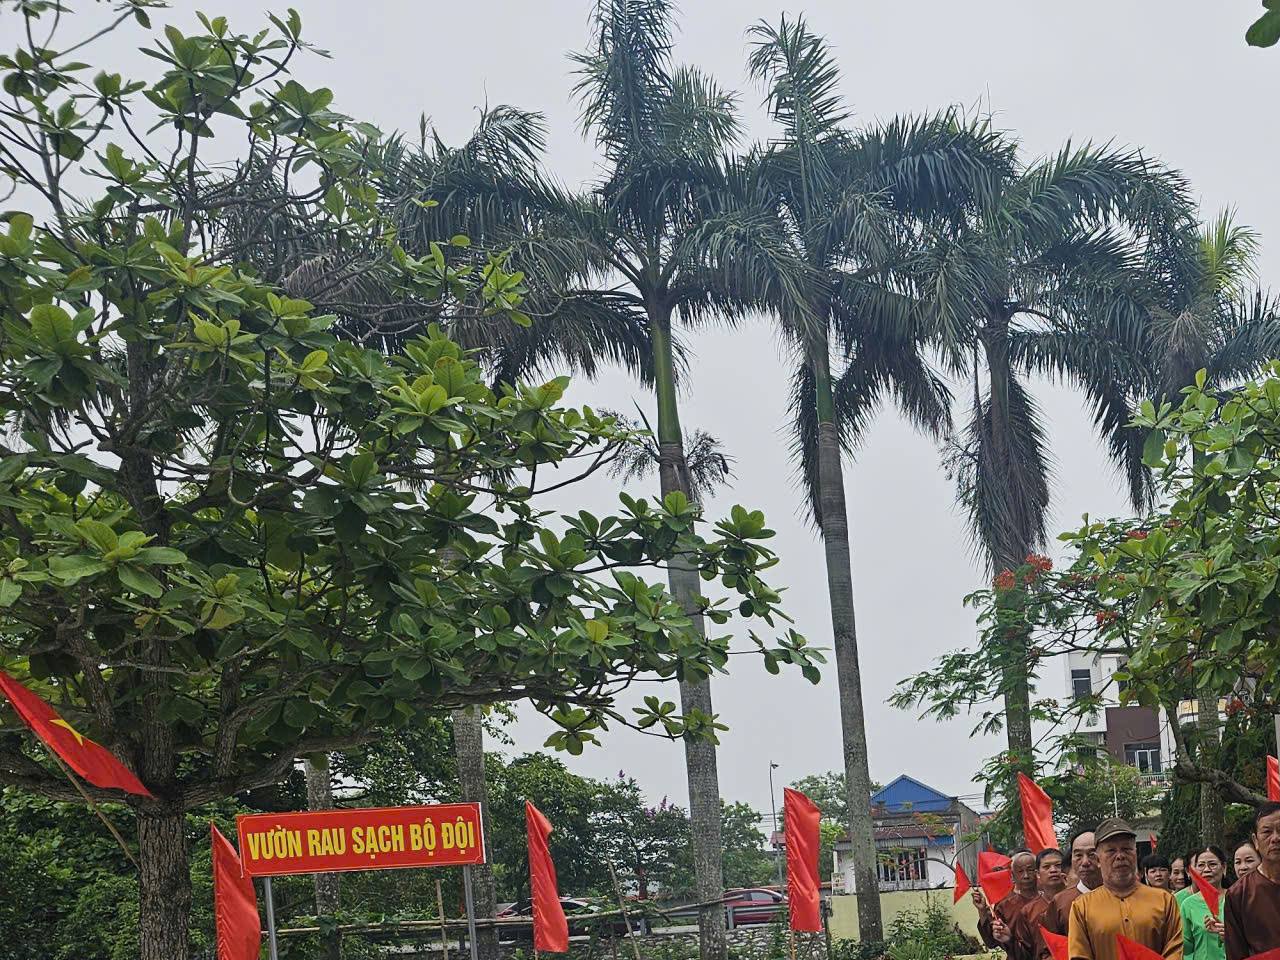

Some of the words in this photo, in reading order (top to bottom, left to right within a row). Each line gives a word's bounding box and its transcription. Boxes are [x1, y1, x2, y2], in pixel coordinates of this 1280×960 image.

[246, 824, 302, 860] VƯỜN
[307, 827, 346, 857] RAU
[351, 824, 405, 860] SẠCH
[409, 817, 436, 857] BỘ
[441, 815, 475, 855] ĐỘI
